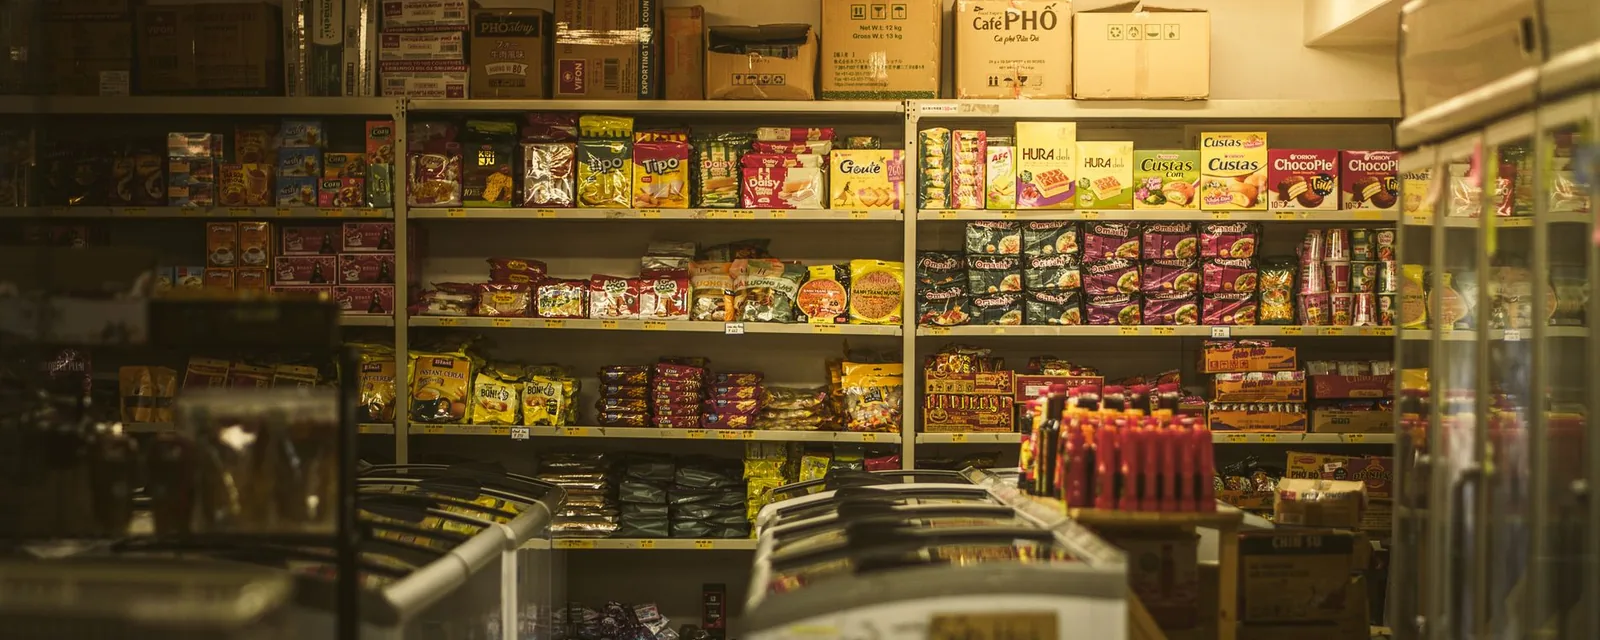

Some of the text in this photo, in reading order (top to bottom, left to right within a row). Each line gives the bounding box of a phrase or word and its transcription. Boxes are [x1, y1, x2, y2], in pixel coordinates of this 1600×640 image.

[324, 0, 332, 33] machi
[973, 3, 1057, 30] Café PHỐ
[574, 63, 582, 90] VIFON
[1204, 137, 1241, 147] Custas
[992, 152, 1008, 162] AFC
[1023, 148, 1054, 160] HURA
[642, 157, 678, 174] Tipo
[704, 160, 734, 171] Daisy
[1084, 158, 1110, 168] HURA
[1141, 158, 1193, 172] Custas
[1208, 158, 1258, 171] Custas
[1274, 159, 1332, 171] ChocoPie
[1349, 160, 1400, 171] ChocoPi
[750, 178, 780, 190] Daisy
[464, 188, 472, 196] 10
[1095, 225, 1128, 237] Omachi
[1154, 223, 1186, 232] Omachi
[606, 281, 626, 291] COCO
[655, 283, 675, 291] COCO
[444, 370, 464, 378] CEREAL
[481, 389, 497, 398] BON!
[528, 386, 543, 394] BON!
